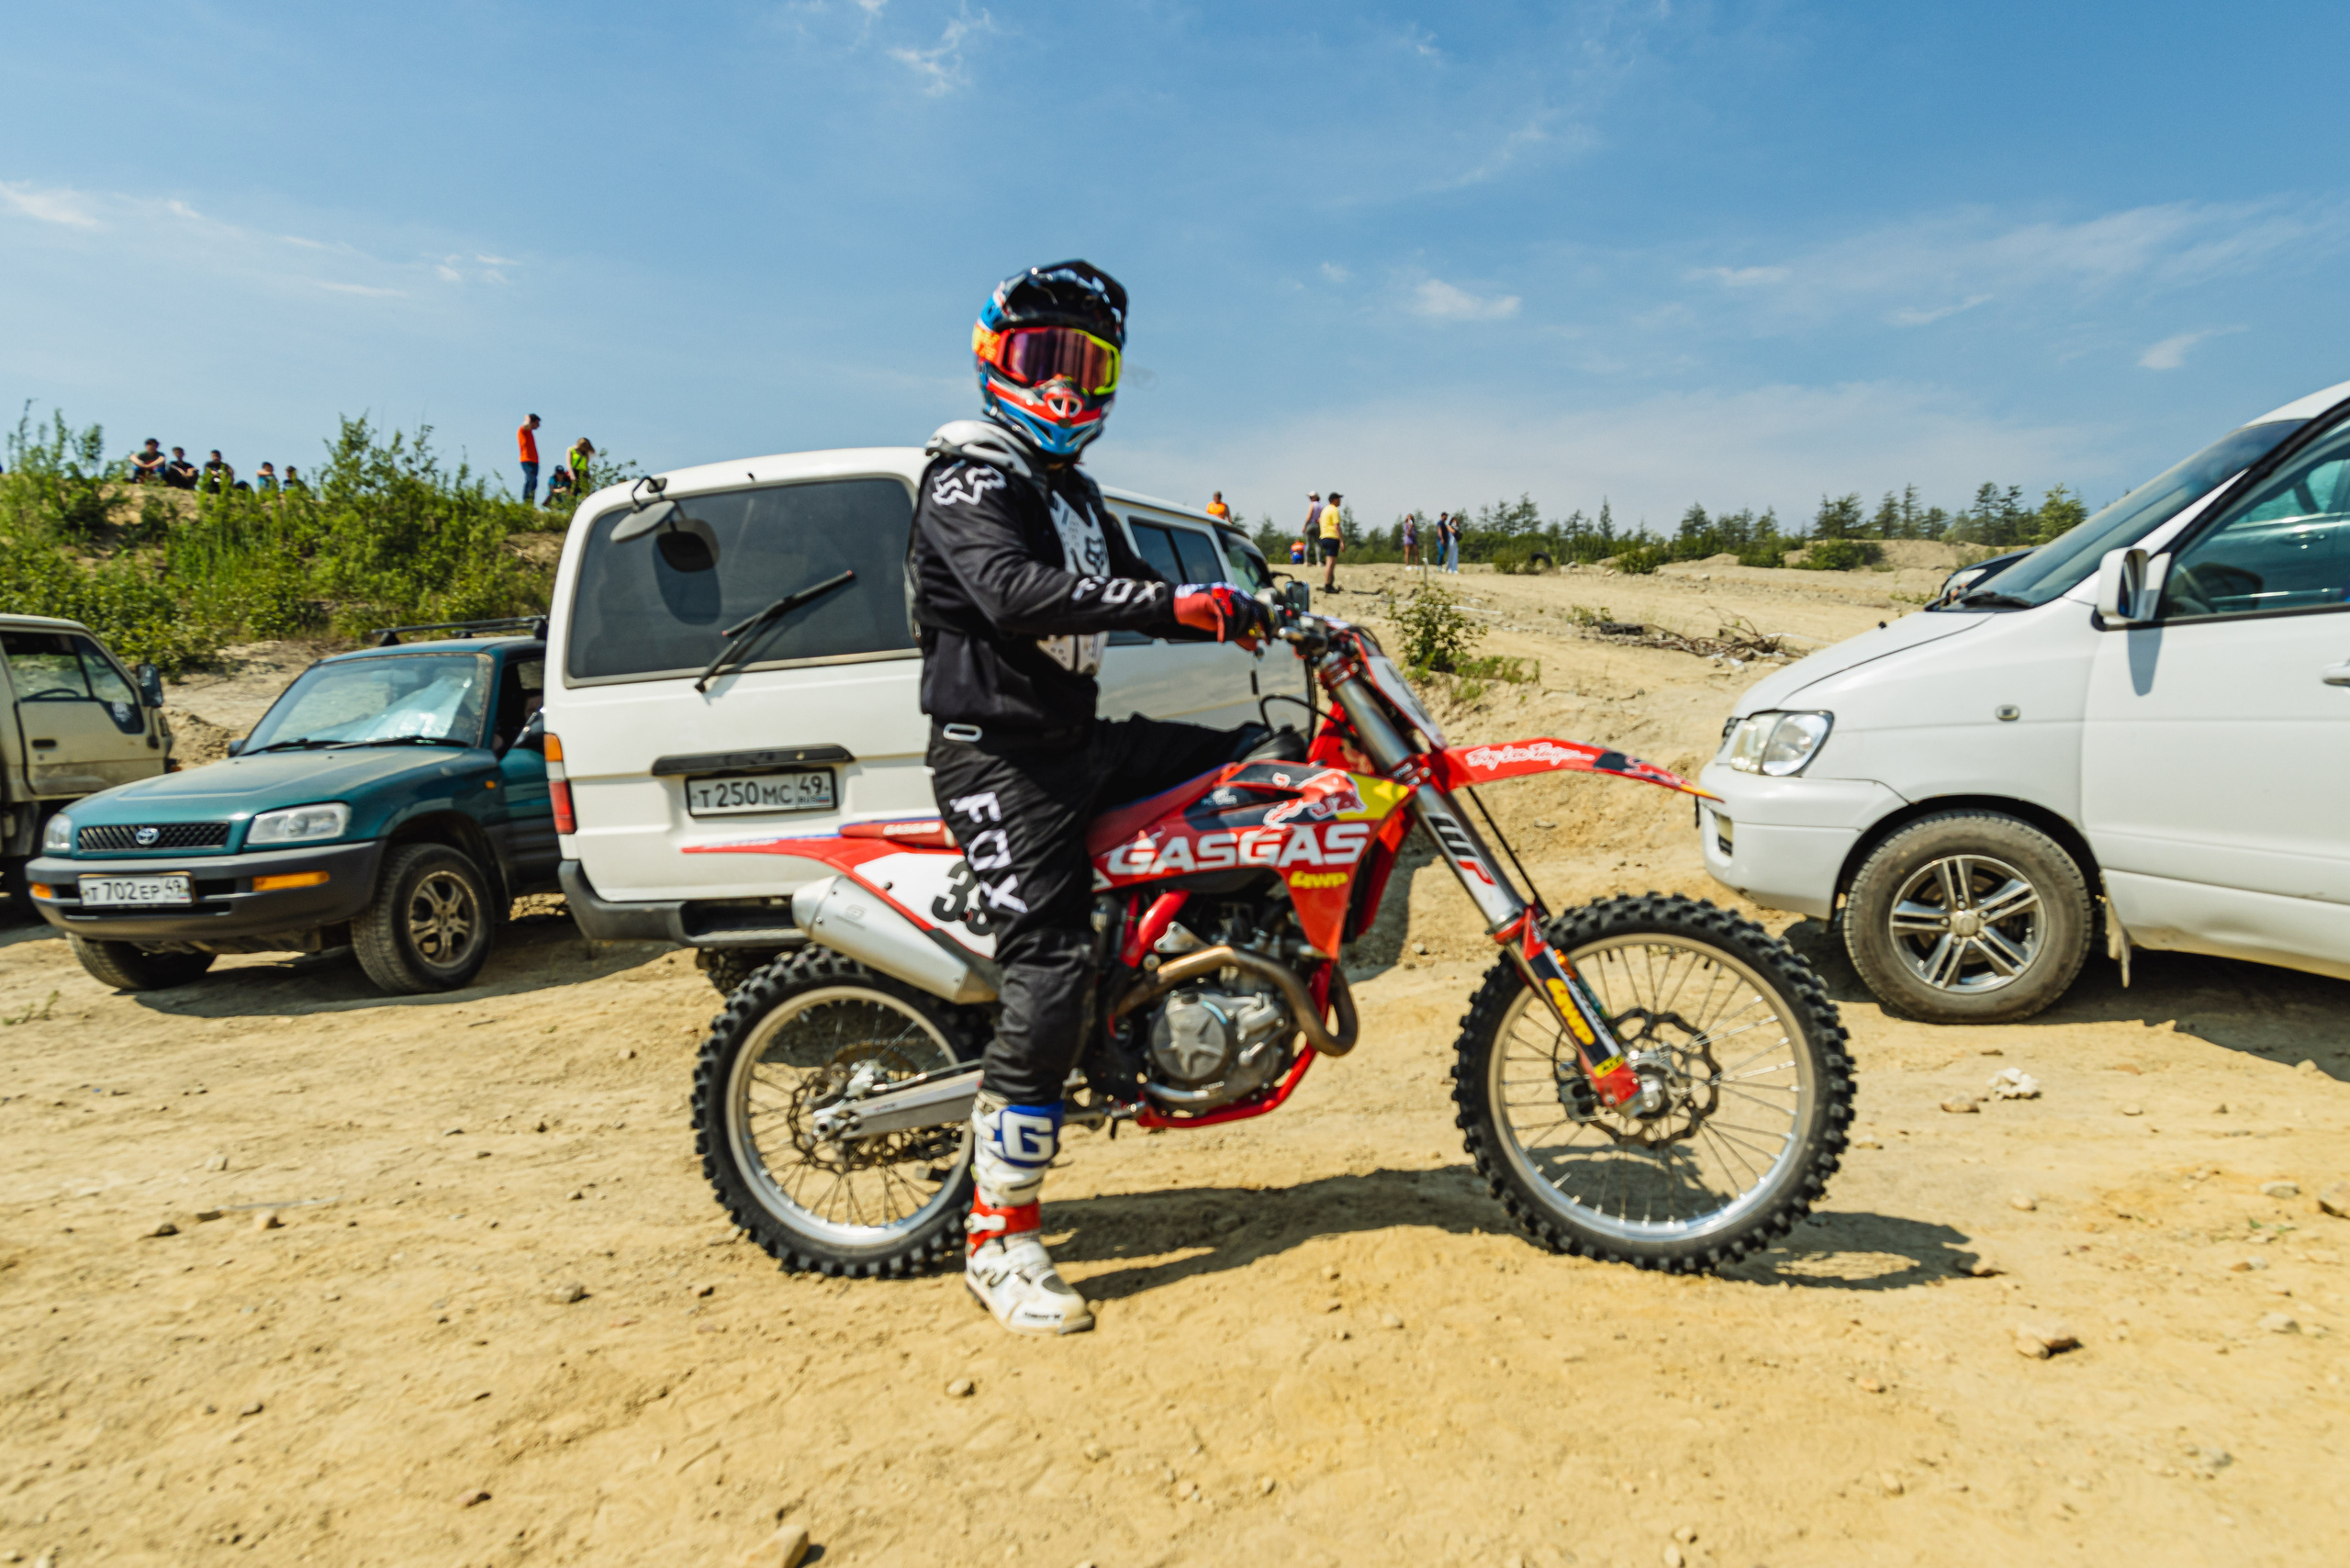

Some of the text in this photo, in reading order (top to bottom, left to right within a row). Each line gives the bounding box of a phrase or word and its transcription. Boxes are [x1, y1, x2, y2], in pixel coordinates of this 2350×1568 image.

[1071, 576, 1166, 604] FOX
[799, 775, 823, 795] 49
[949, 791, 1028, 913] FOX
[1107, 823, 1371, 875] GASGAS
